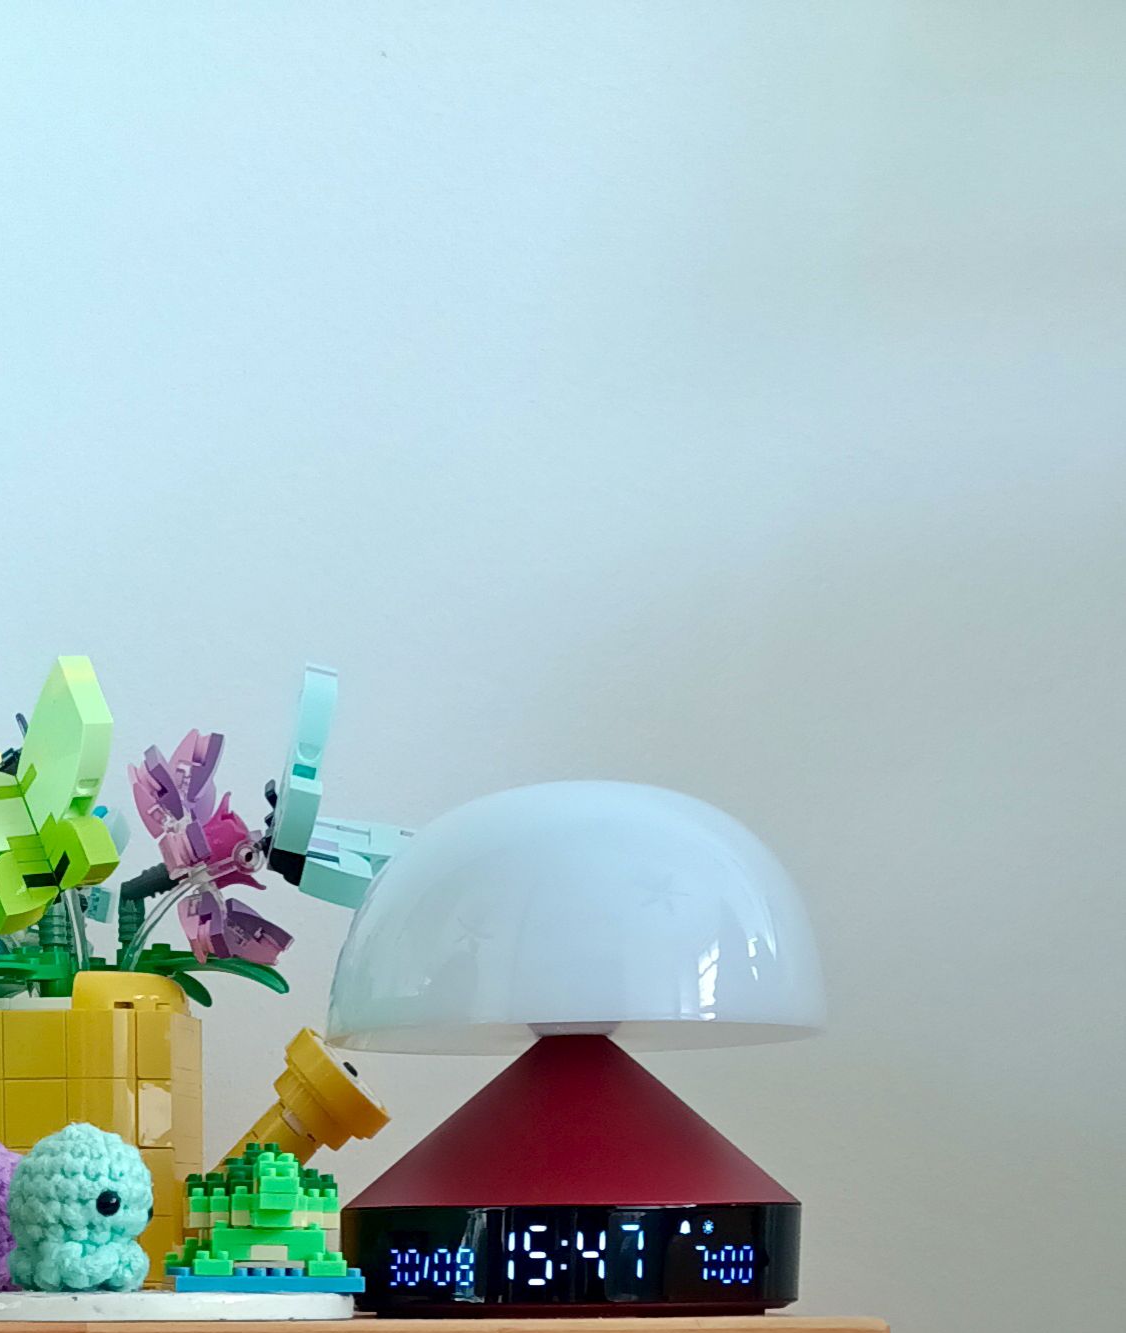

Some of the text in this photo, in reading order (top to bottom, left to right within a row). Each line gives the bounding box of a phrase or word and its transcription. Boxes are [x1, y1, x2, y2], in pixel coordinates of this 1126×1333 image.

[389, 1247, 475, 1287] 30/08
[507, 1224, 646, 1286] 15:47
[695, 1244, 754, 1285] 7:00
